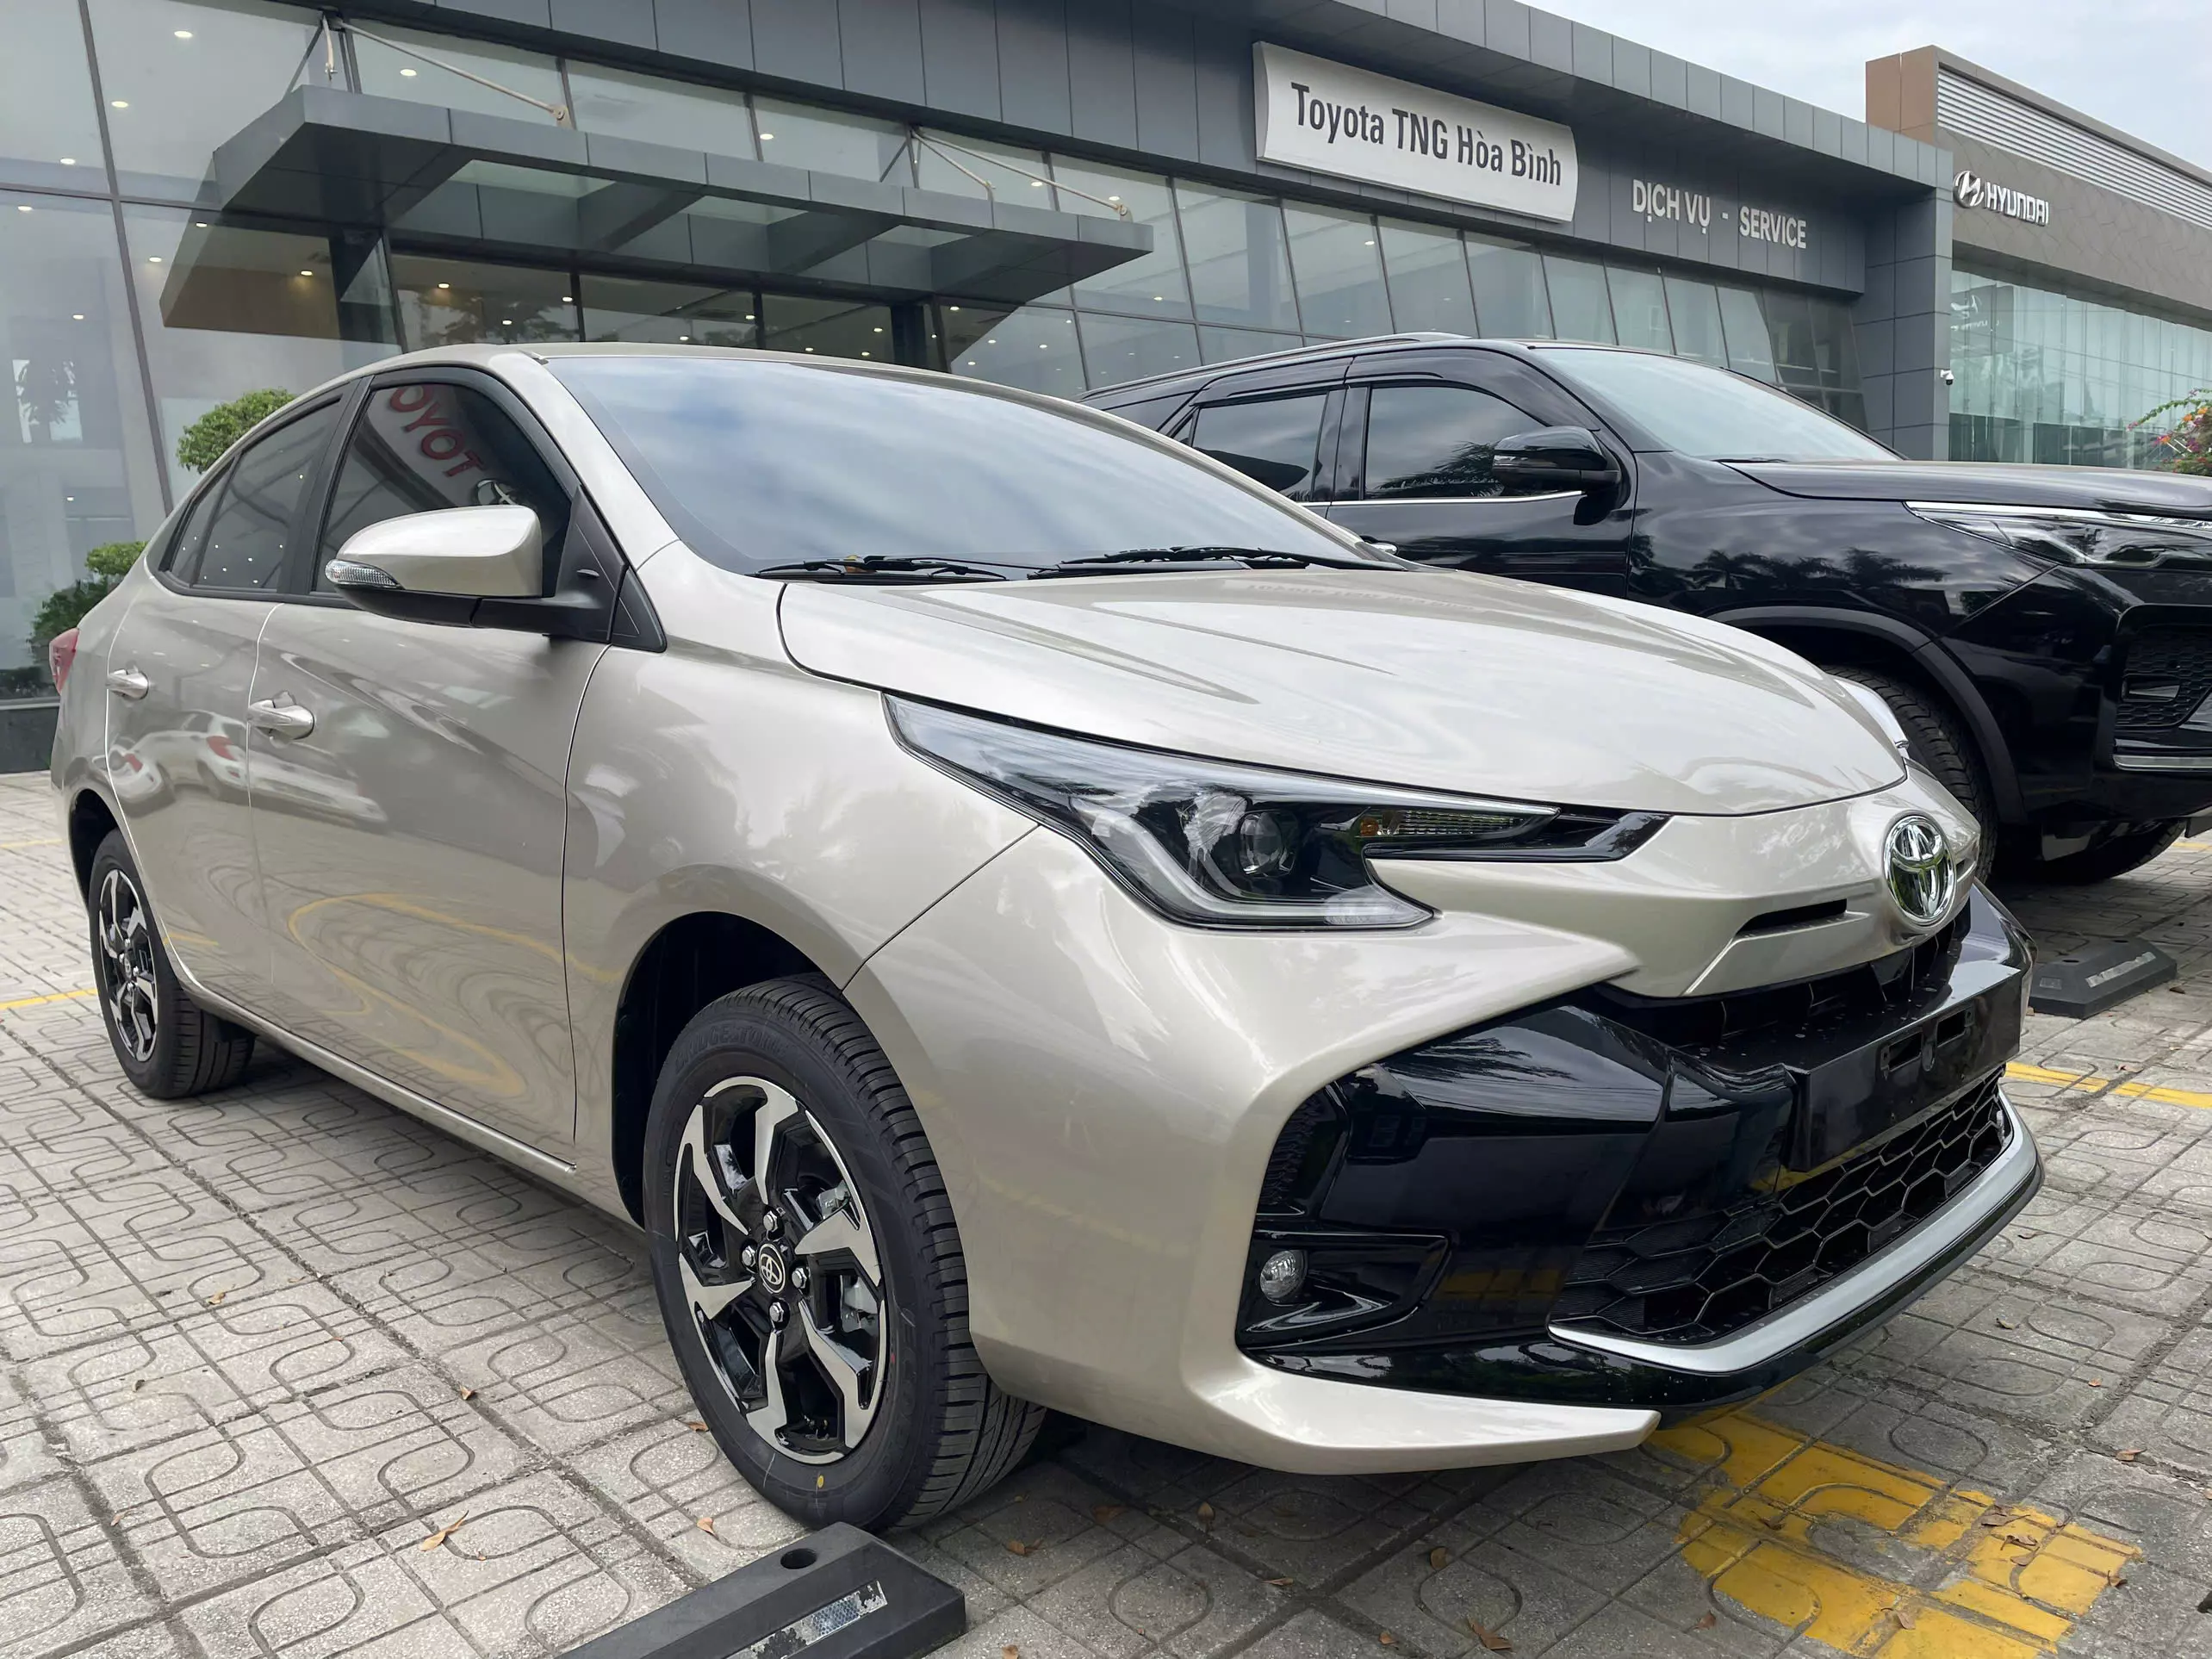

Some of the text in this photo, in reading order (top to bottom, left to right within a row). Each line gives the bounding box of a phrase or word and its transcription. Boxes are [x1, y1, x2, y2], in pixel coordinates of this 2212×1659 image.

[1290, 82, 1562, 186] Toyota TNG Hòa Bình
[1632, 178, 1680, 223] DỊCH
[1684, 191, 1711, 235] VỤ
[1739, 206, 1807, 249] SERVICE
[1985, 181, 2049, 226] HYUNDAI
